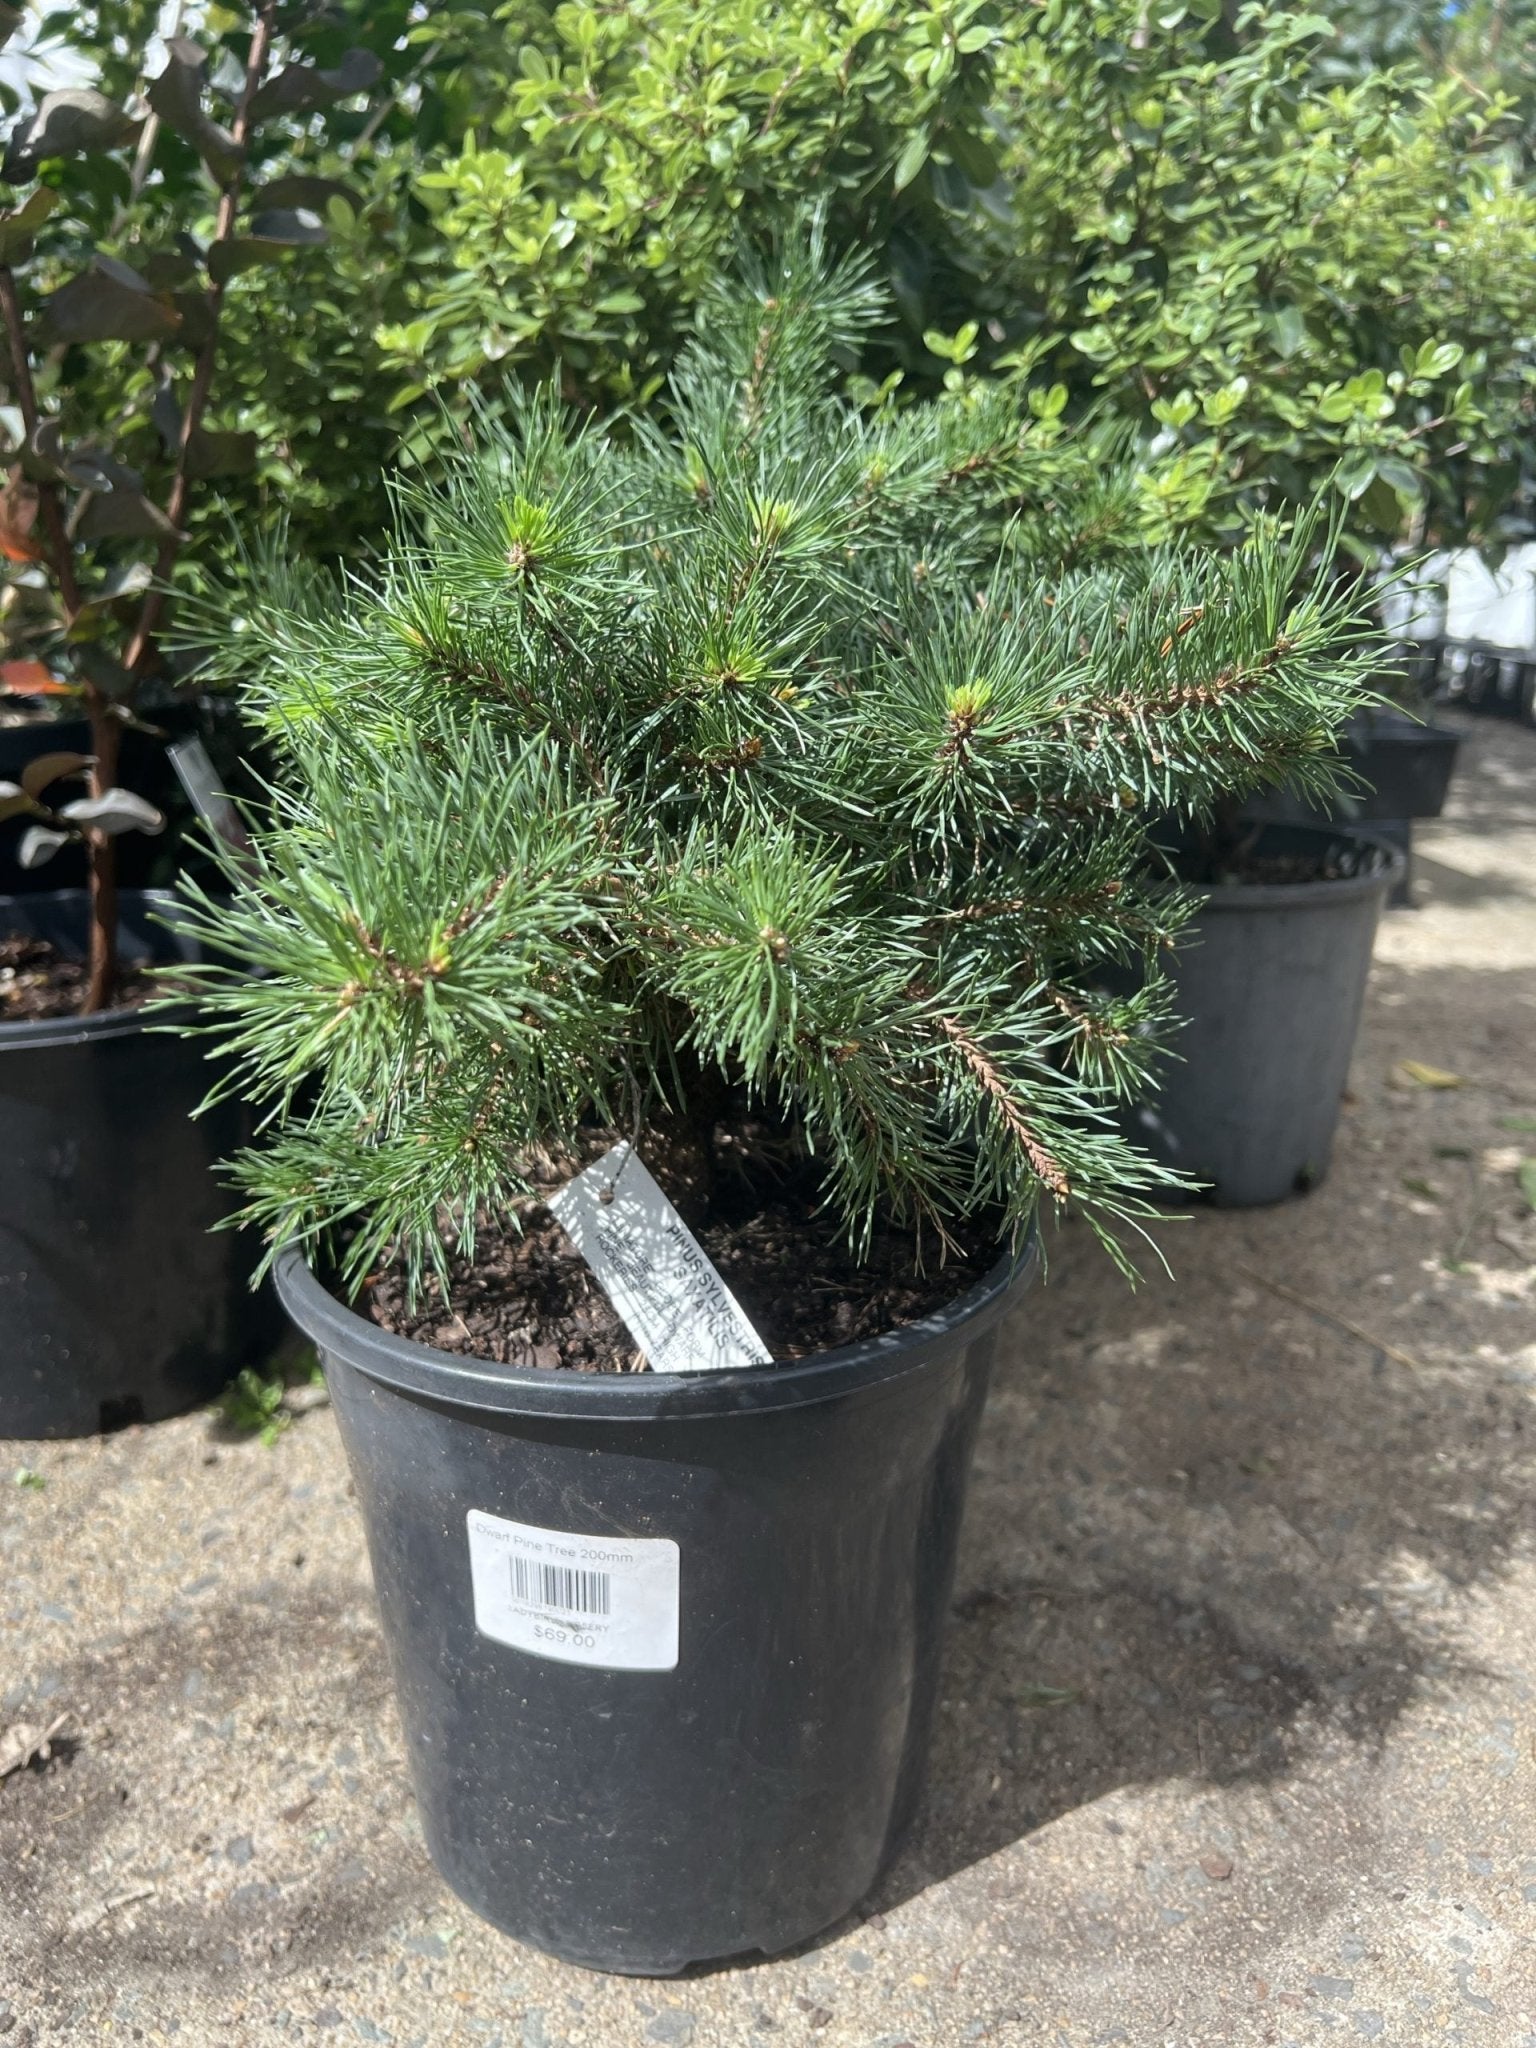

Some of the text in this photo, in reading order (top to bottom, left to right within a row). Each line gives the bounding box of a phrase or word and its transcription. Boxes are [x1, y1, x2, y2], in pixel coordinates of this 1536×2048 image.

[594, 1232, 639, 1293] ROCKERIES
[664, 1223, 765, 1365] PINUS SYLVESTRIS
[671, 1265, 732, 1350] SAXATILIS
[476, 1523, 634, 1563] Dwarf Pine Tree 200mm
[534, 1625, 595, 1648] $69.00
